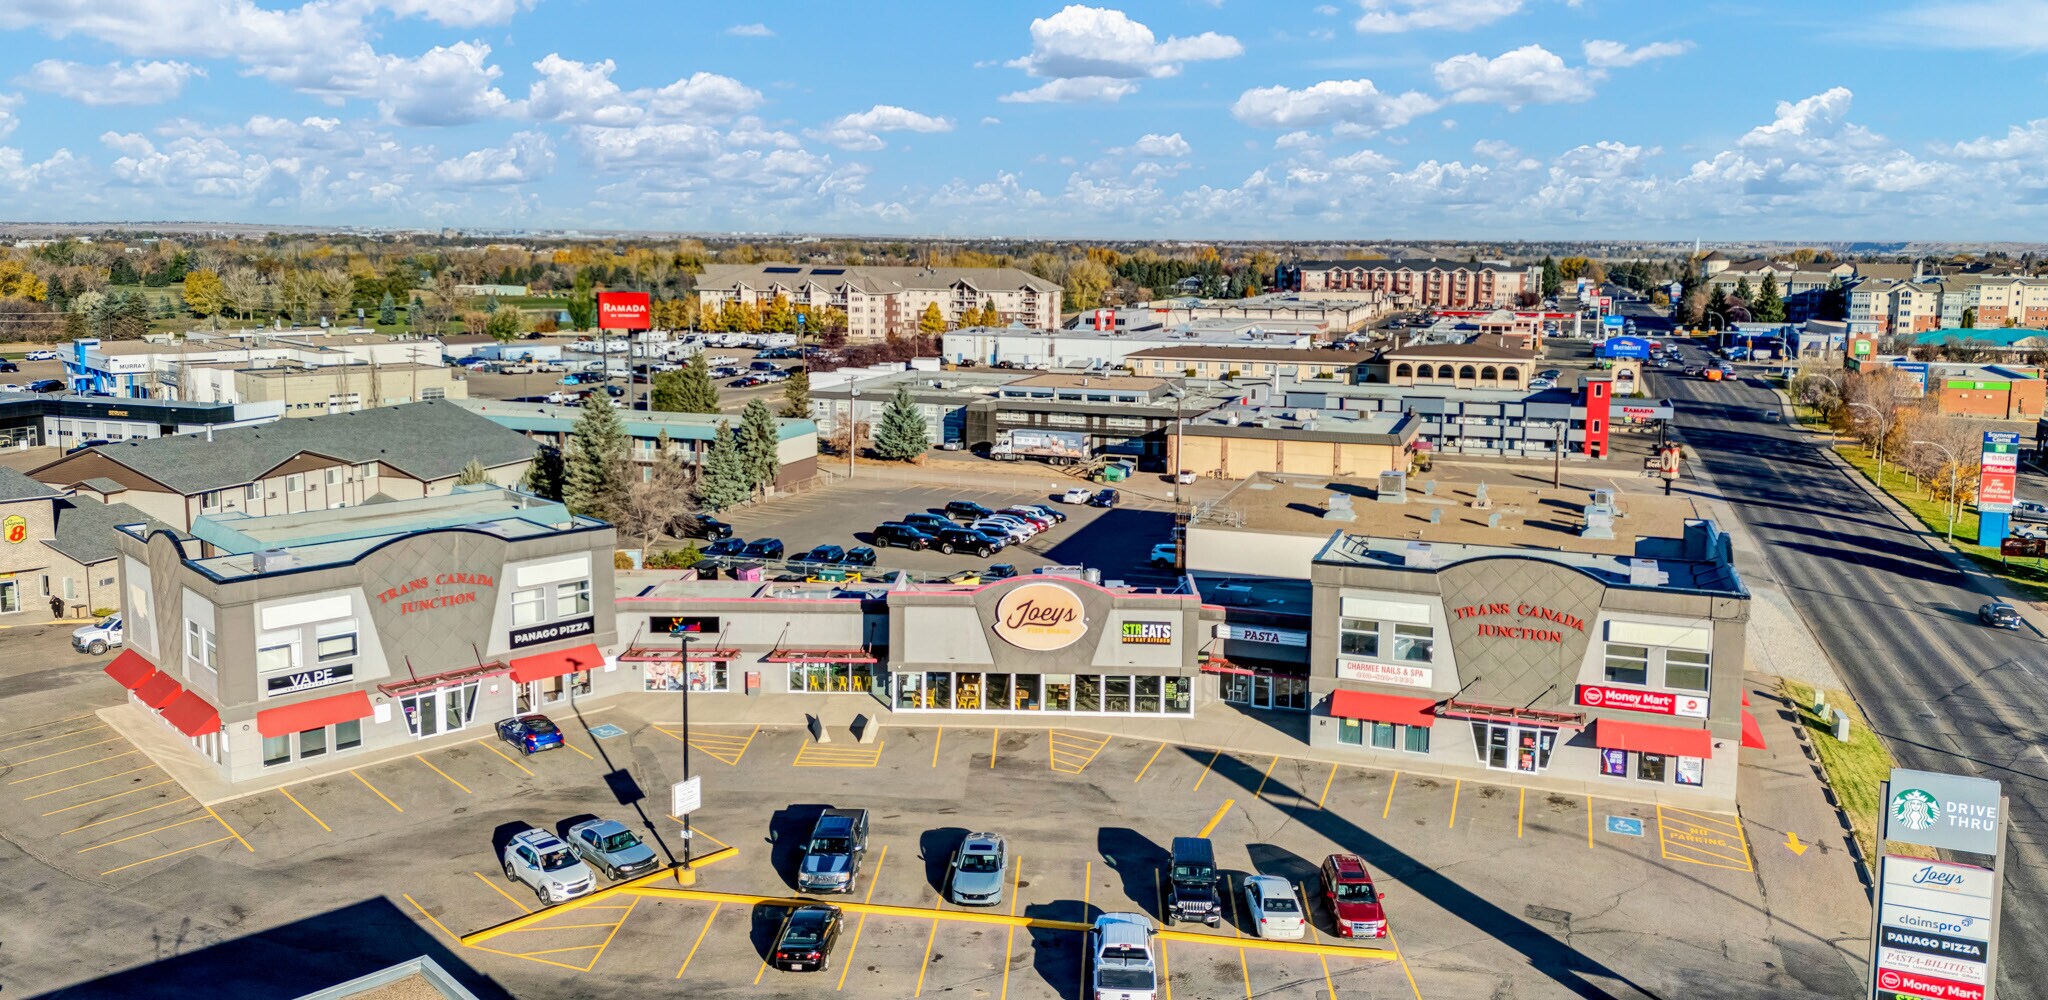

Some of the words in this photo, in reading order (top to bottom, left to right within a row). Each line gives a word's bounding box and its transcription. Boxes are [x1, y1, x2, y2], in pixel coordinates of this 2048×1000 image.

[603, 303, 646, 312] RAMADA
[1623, 406, 1654, 414] RAMADA
[1984, 486, 2010, 495] Hortons
[1991, 479, 2004, 487] Tim
[10, 525, 25, 542] 8
[377, 577, 429, 604] TRANS
[435, 573, 494, 587] CANADA
[401, 592, 476, 616] JUNCTION
[1006, 600, 1077, 629] Joeys
[1454, 603, 1510, 620] TRANS
[1517, 603, 1585, 632] CANADA
[514, 628, 558, 644] PANAGO
[559, 621, 590, 635] PIZZA
[1123, 623, 1171, 638] STREATS
[1244, 630, 1280, 643] PASTA
[1477, 624, 1563, 643] JUNCTION
[1347, 662, 1380, 672] CHARMEE
[1381, 665, 1401, 675] NAILS
[1410, 669, 1424, 678] SPA
[1605, 690, 1642, 704] Money
[1644, 694, 1669, 706] Mart
[1946, 801, 1996, 818] DRIVE
[1689, 827, 1708, 836] NO
[1948, 815, 1994, 831] THRU
[1670, 832, 1726, 847] PARKING
[1913, 866, 1965, 885] Joeys
[1899, 914, 1962, 932] claimspro
[1887, 932, 1939, 948] PANAGO
[1941, 940, 1980, 955] PIZZA
[1886, 952, 1975, 975] PASTA-BILITIES
[1903, 978, 1944, 994] Money
[1947, 985, 1978, 1000] Mart
